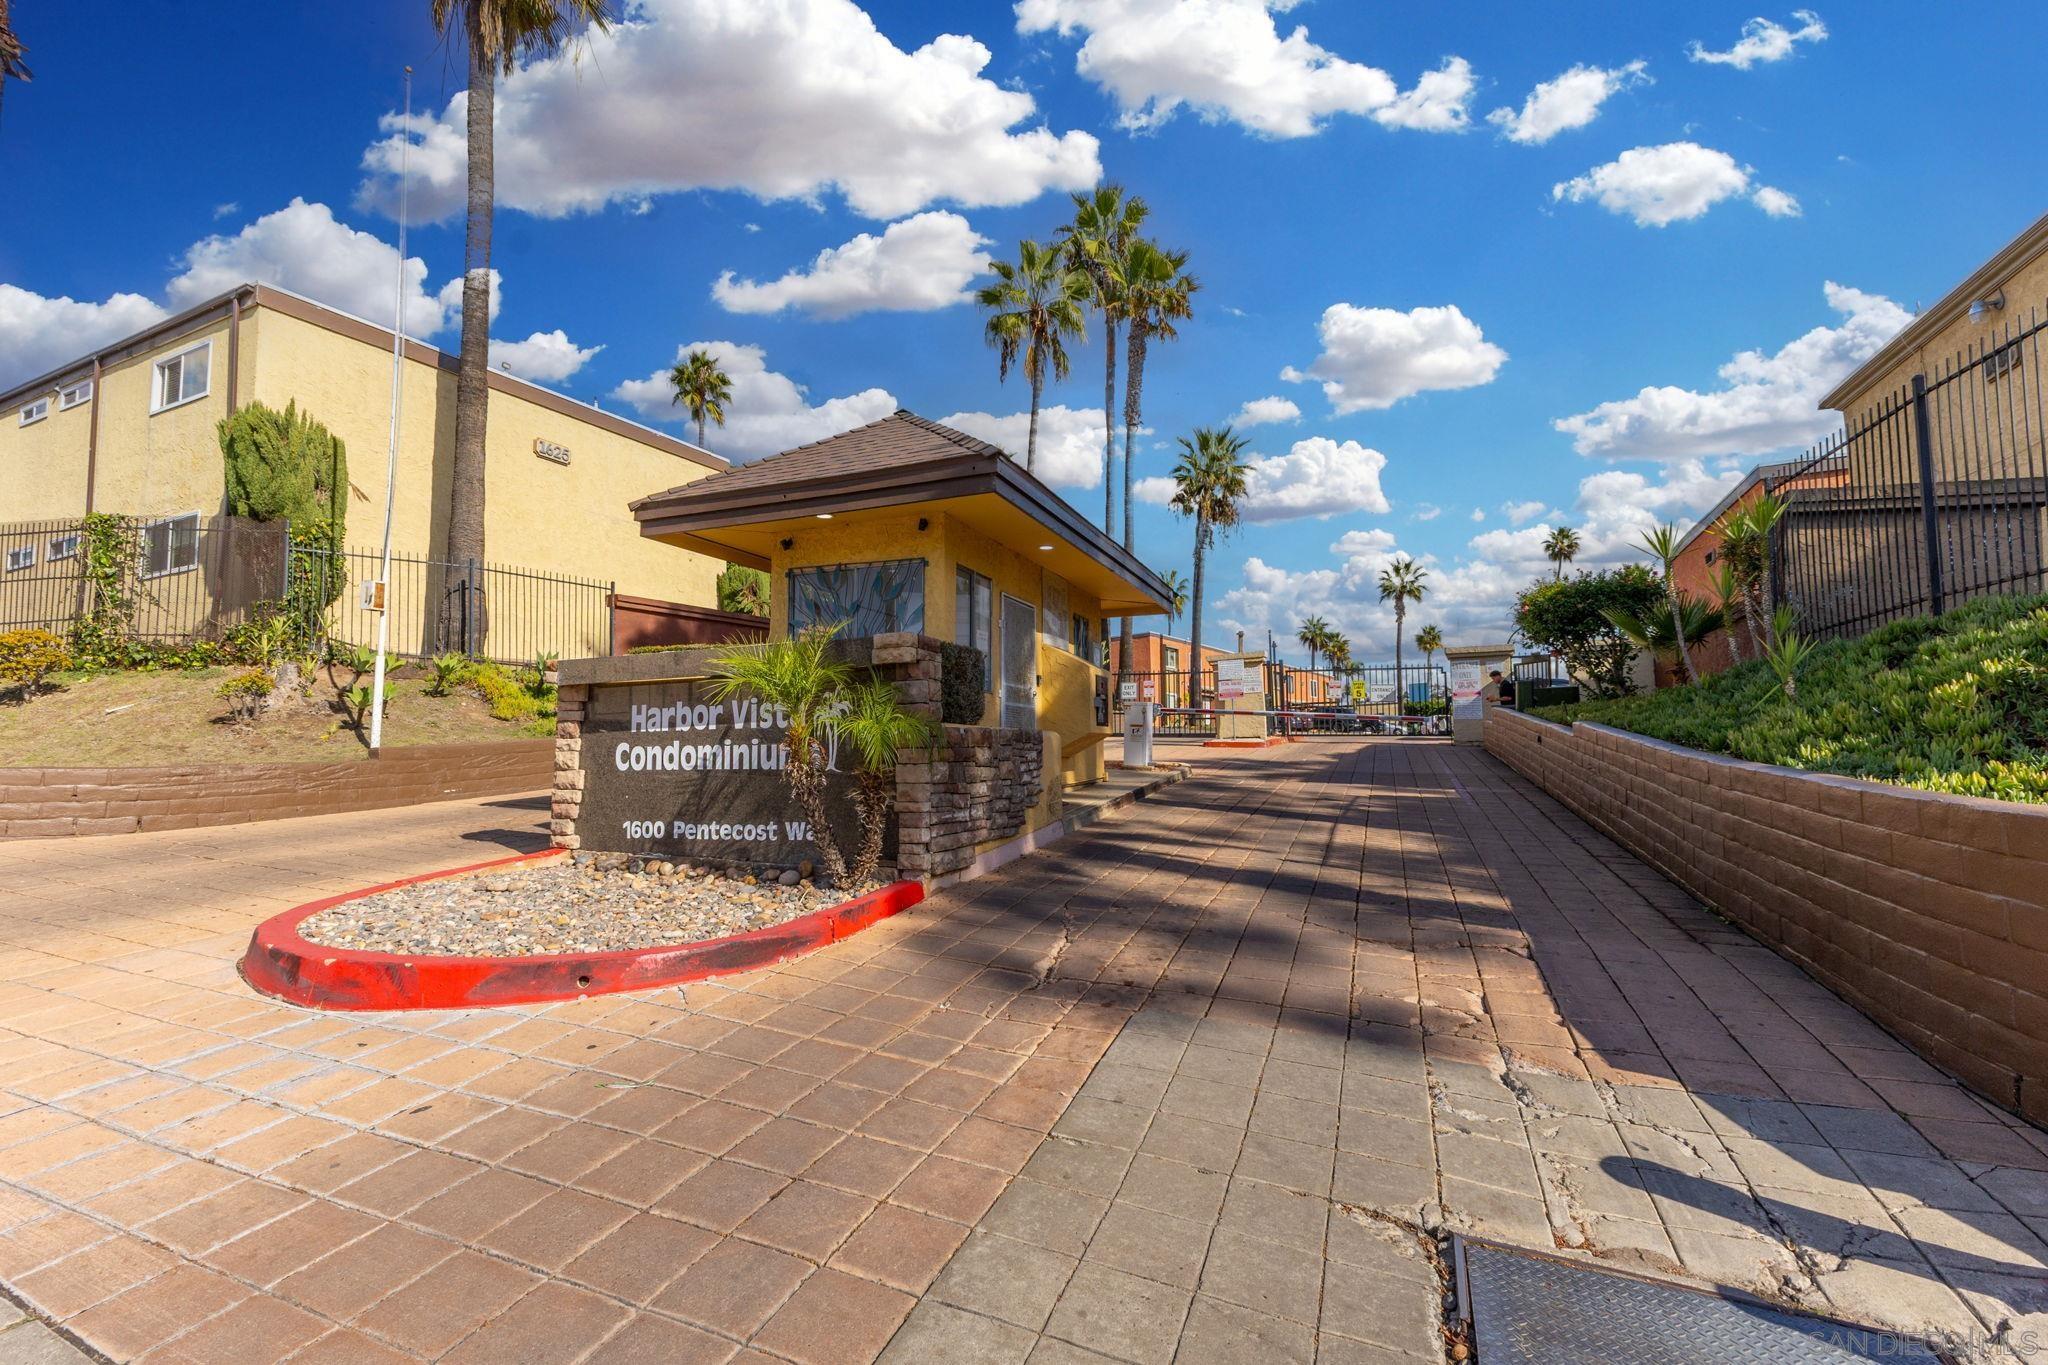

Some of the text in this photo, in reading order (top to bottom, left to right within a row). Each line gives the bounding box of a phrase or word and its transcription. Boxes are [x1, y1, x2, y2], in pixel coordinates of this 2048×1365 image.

[539, 440, 570, 462] 1625
[631, 697, 795, 733] Harbor Vist
[622, 820, 665, 840] 1600
[673, 820, 777, 842] Pentecost
